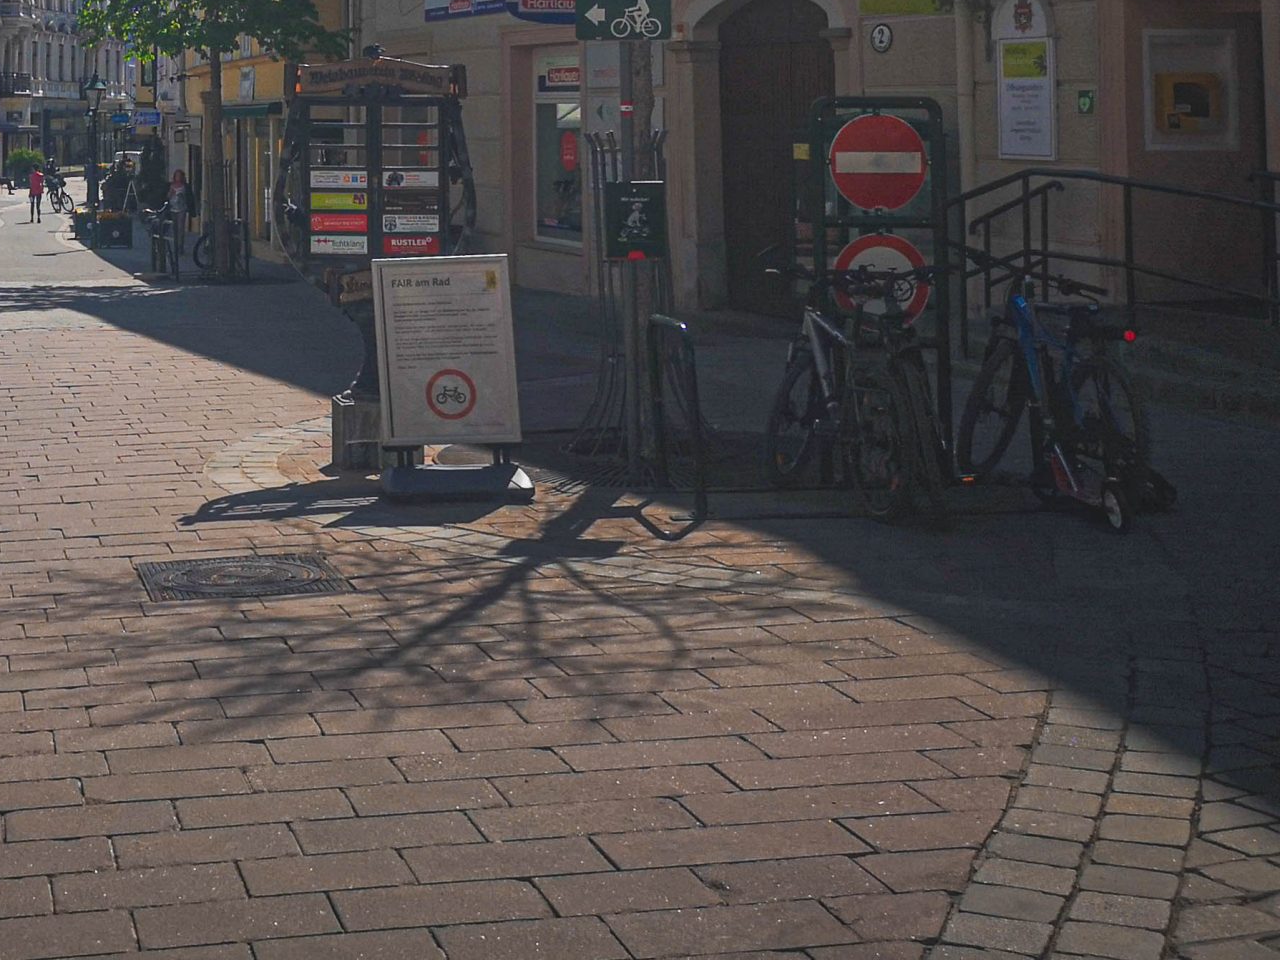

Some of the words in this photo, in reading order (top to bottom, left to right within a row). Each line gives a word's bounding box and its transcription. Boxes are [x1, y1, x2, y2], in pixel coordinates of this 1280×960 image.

[877, 28, 885, 44] 2
[391, 279, 412, 288] FAIR
[415, 279, 429, 287] am
[432, 277, 450, 287] Rad
